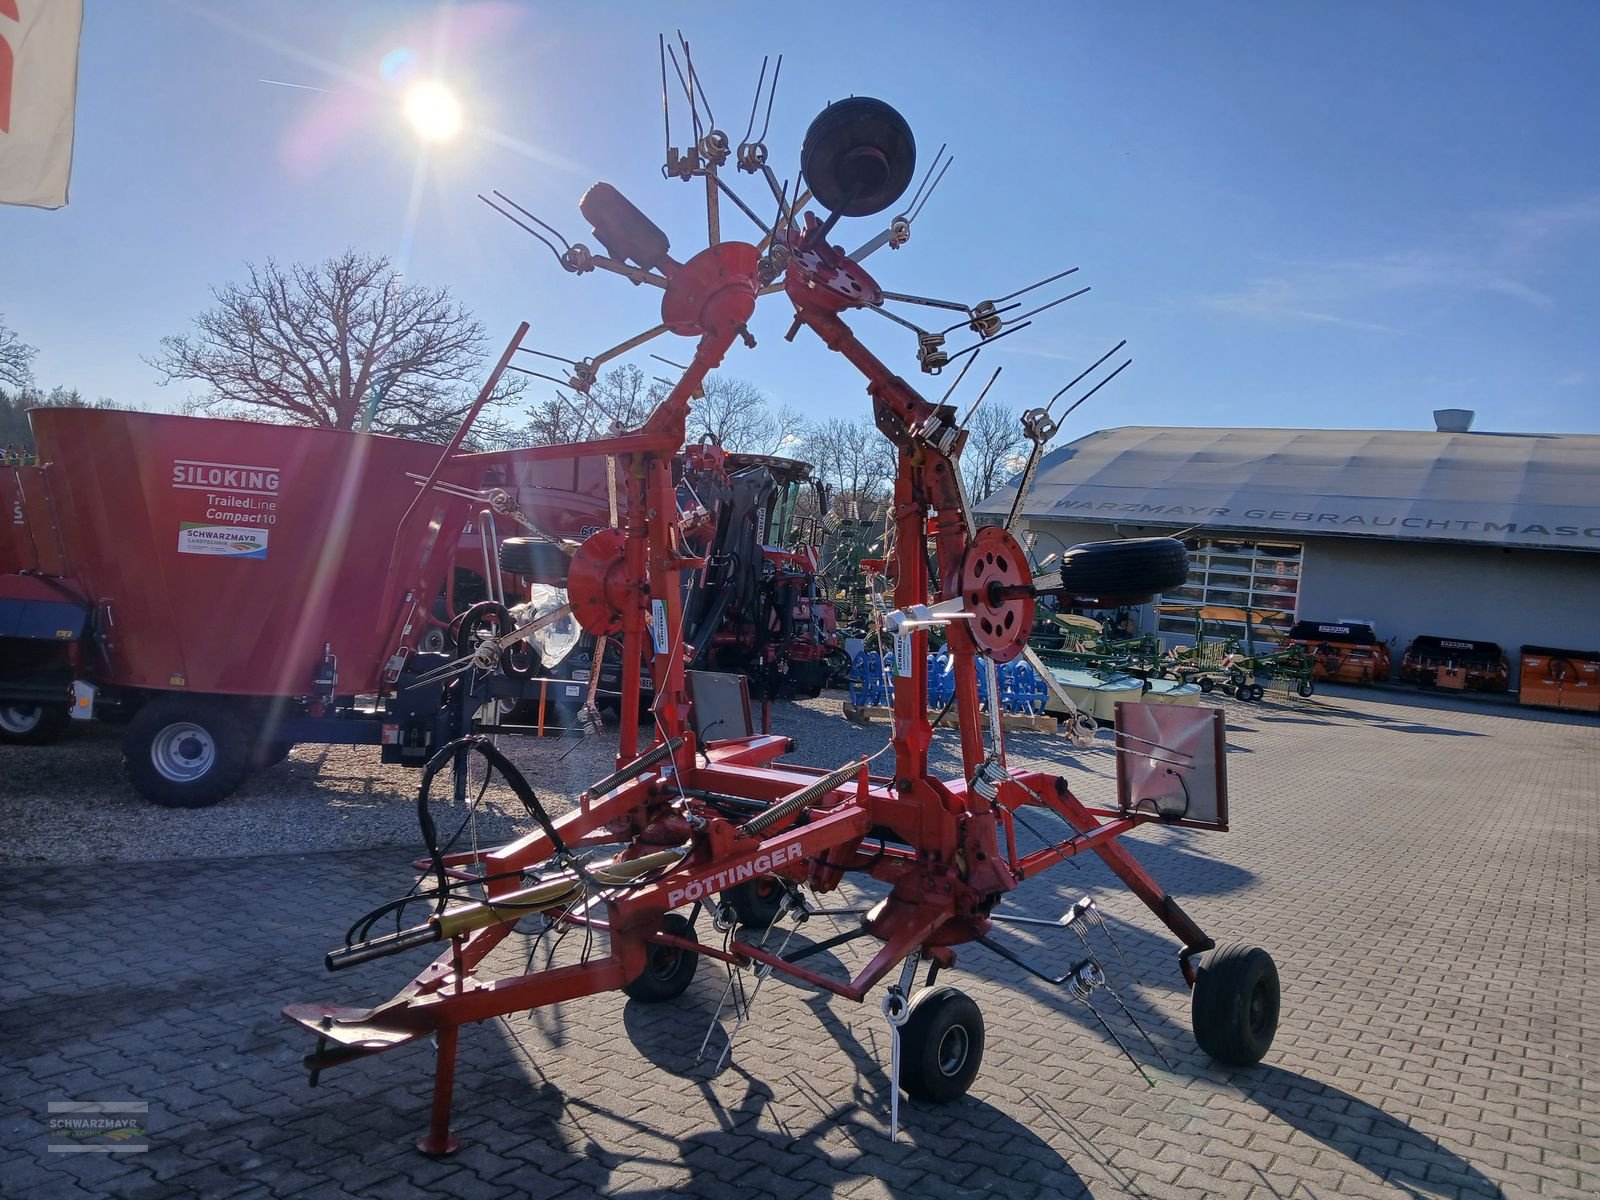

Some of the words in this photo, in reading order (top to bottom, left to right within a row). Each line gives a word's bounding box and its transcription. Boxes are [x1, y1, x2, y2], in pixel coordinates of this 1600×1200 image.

[173, 466, 279, 490] SILOKING
[207, 494, 276, 511] TrailedLine
[1000, 500, 1231, 517] SHWARZMAYR
[187, 529, 256, 543] SCHWARZMAYR
[667, 842, 803, 909] PÖTTINGER
